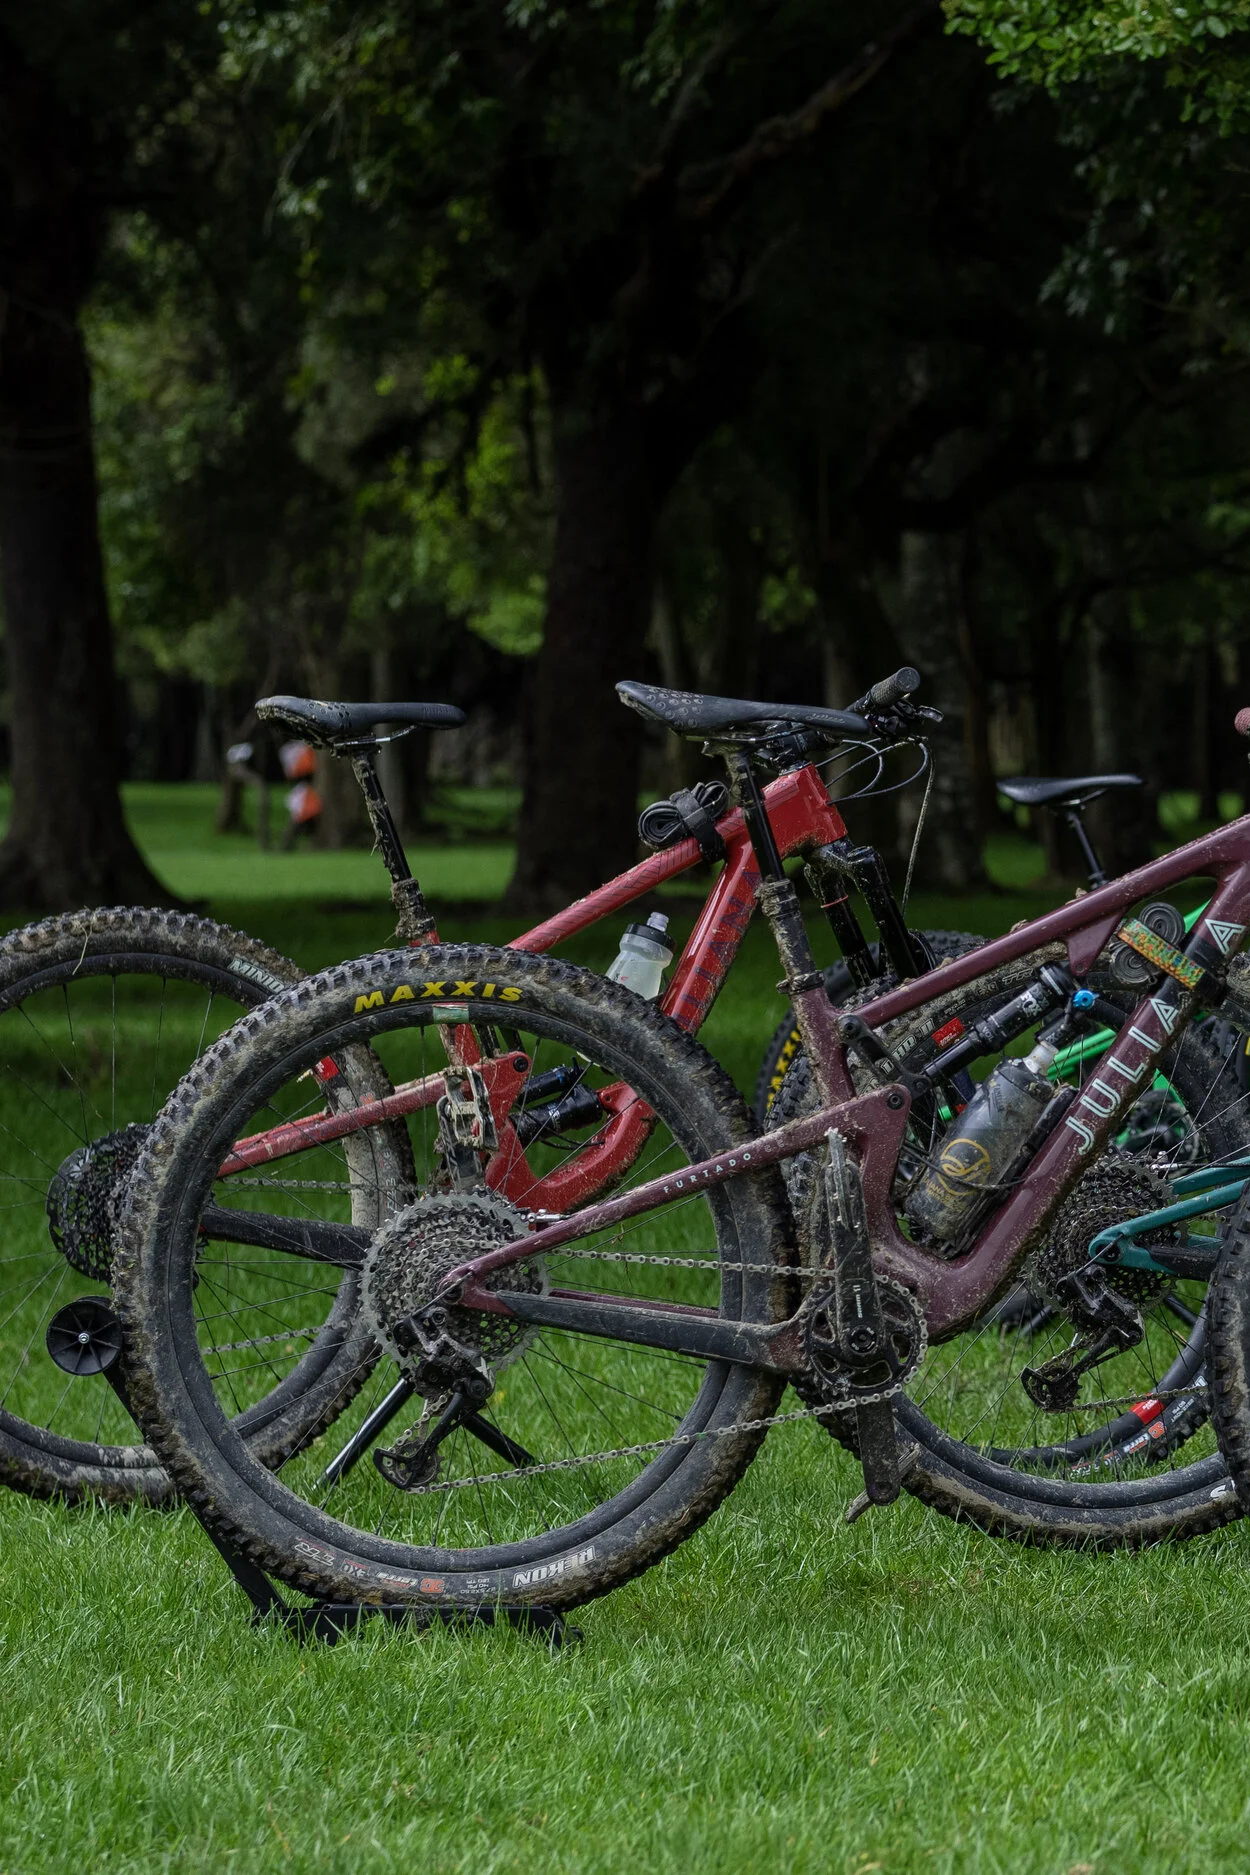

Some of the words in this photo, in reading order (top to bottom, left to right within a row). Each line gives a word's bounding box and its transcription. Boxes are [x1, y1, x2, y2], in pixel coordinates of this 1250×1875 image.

[354, 980, 523, 1014] MAXXIS
[1065, 918, 1246, 1155] JULIAA
[663, 1152, 752, 1194] FURTADO
[512, 1545, 597, 1588] REKON
